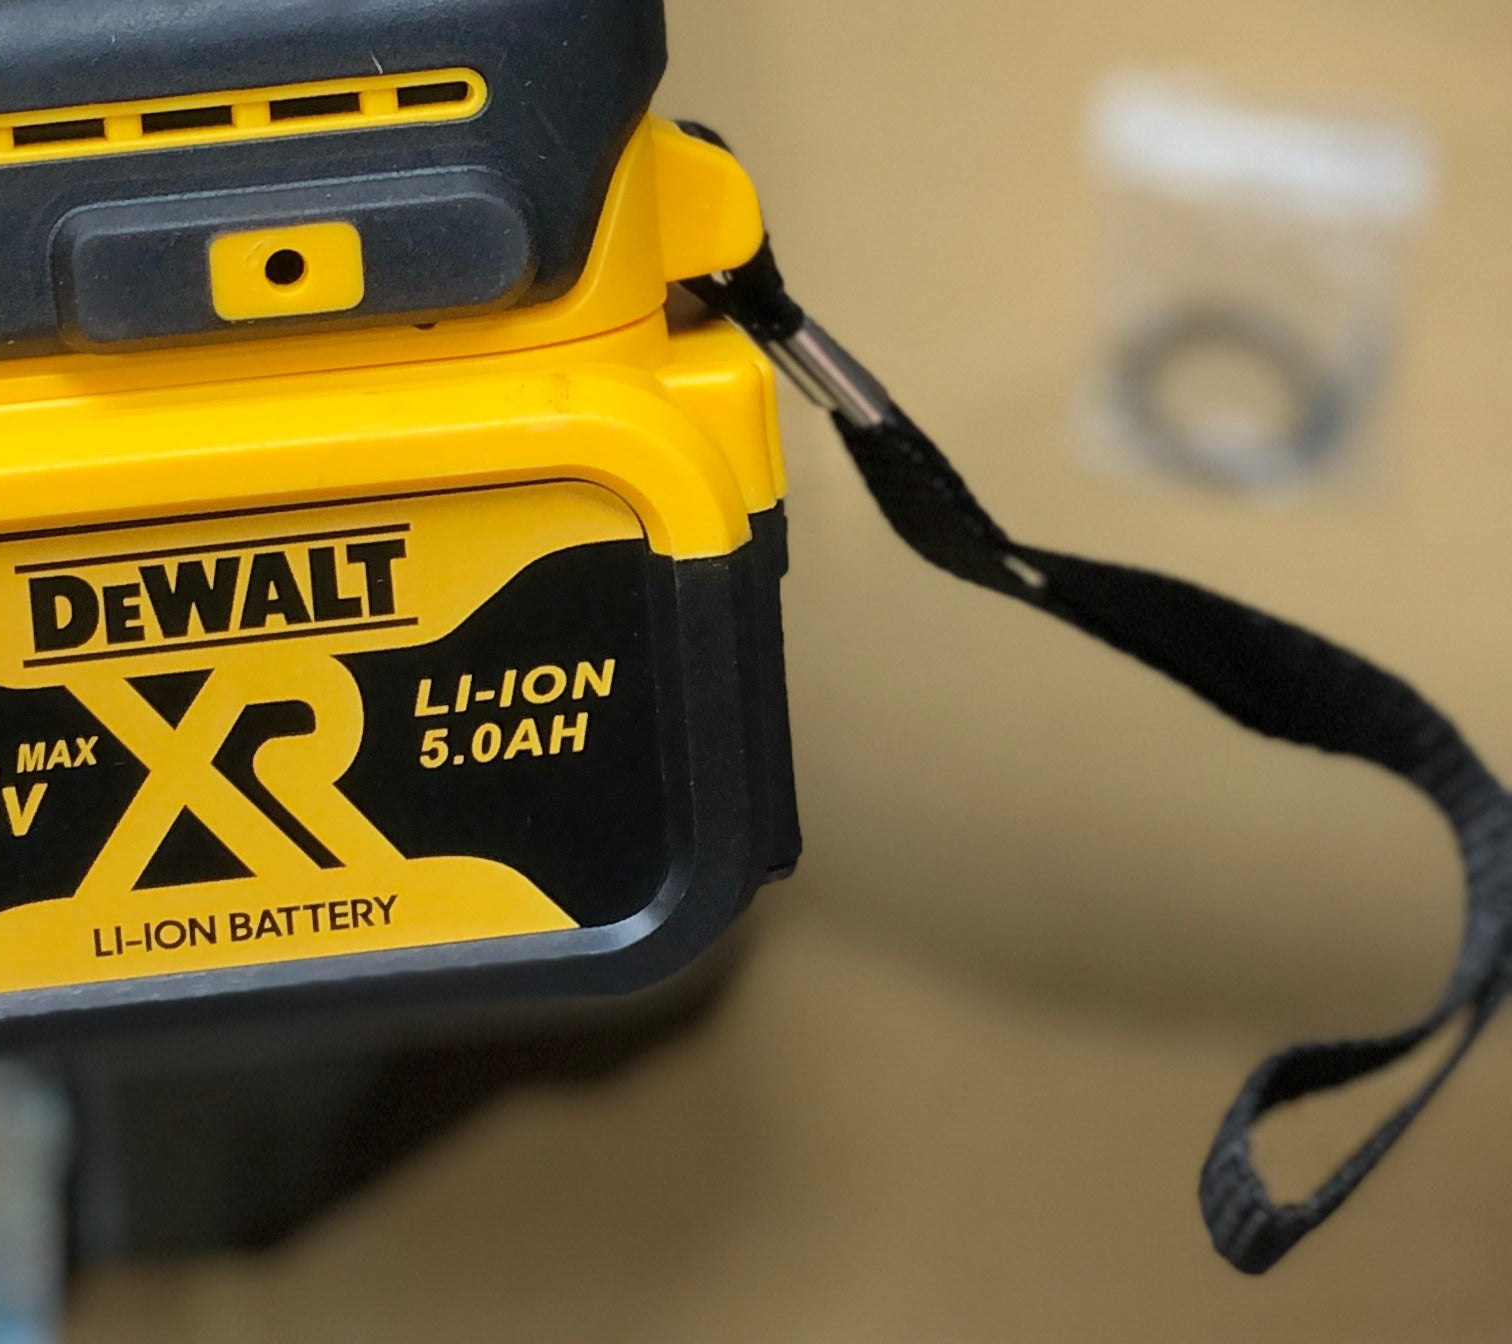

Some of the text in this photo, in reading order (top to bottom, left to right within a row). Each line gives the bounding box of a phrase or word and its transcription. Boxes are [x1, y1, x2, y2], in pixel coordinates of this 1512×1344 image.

[414, 657, 618, 718] LI-ION
[16, 735, 100, 774] MAX
[418, 712, 590, 770] 5.0AH
[66, 653, 410, 898] XR
[92, 895, 399, 959] LI-ION BATTERY
